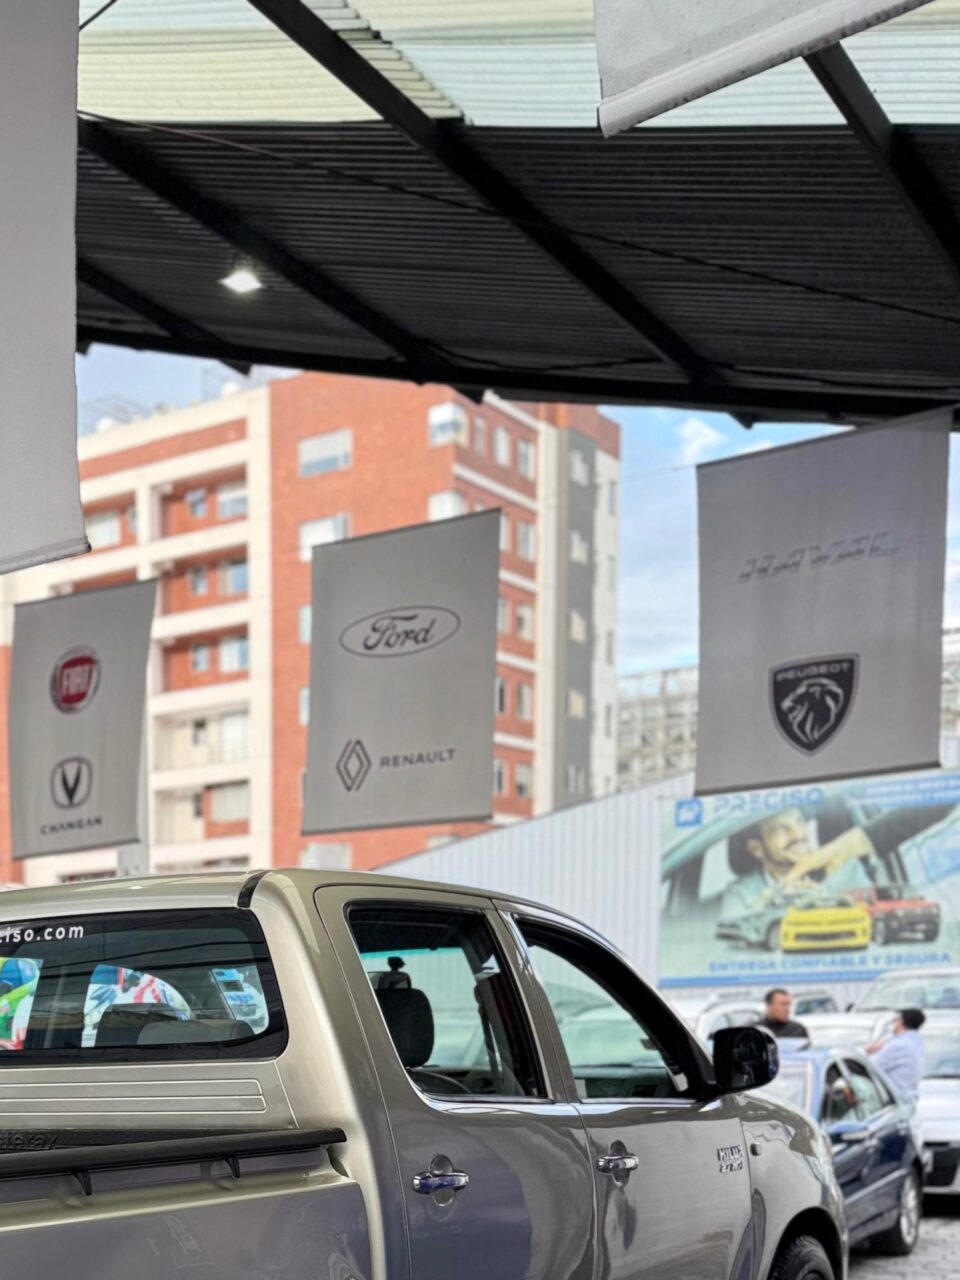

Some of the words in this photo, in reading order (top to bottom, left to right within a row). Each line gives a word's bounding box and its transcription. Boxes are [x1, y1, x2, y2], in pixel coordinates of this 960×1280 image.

[363, 613, 437, 651] Ford
[62, 662, 90, 697] FIAT
[775, 662, 852, 683] PEUGEOT
[380, 748, 456, 769] RENAULT
[713, 786, 825, 813] PRECISO
[41, 817, 103, 836] CHANGAN
[709, 957, 776, 972] ENTREGA
[780, 954, 869, 970] CONFIABLE
[885, 950, 951, 965] SEGURA
